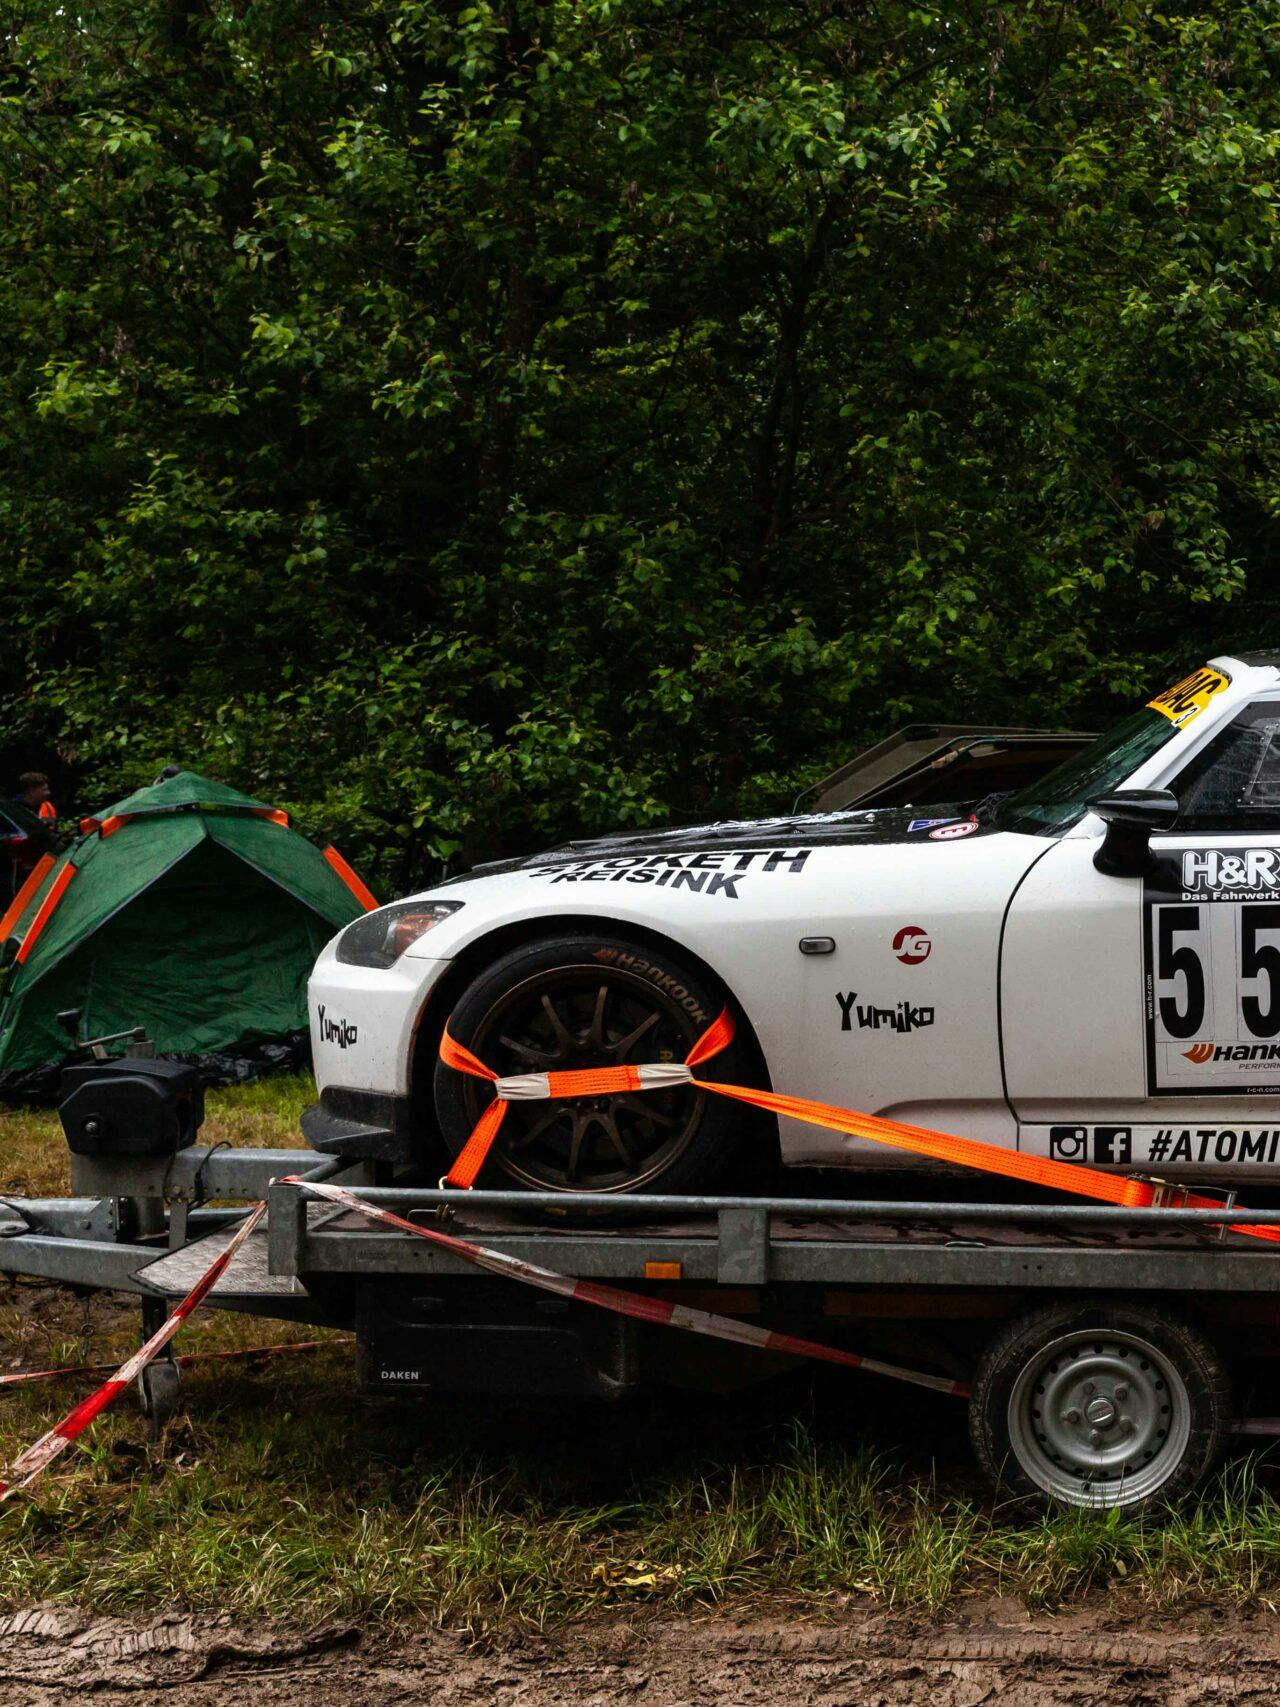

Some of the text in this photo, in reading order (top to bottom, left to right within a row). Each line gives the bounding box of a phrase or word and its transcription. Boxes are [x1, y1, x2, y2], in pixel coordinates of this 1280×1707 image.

[549, 868, 747, 900] REISINK
[1181, 891, 1209, 901] Das
[835, 991, 935, 1033] Yumiko
[317, 1004, 358, 1049] Yumiko
[1246, 1086, 1280, 1094] r-c-n.com
[381, 1370, 419, 1380] DAKEN
